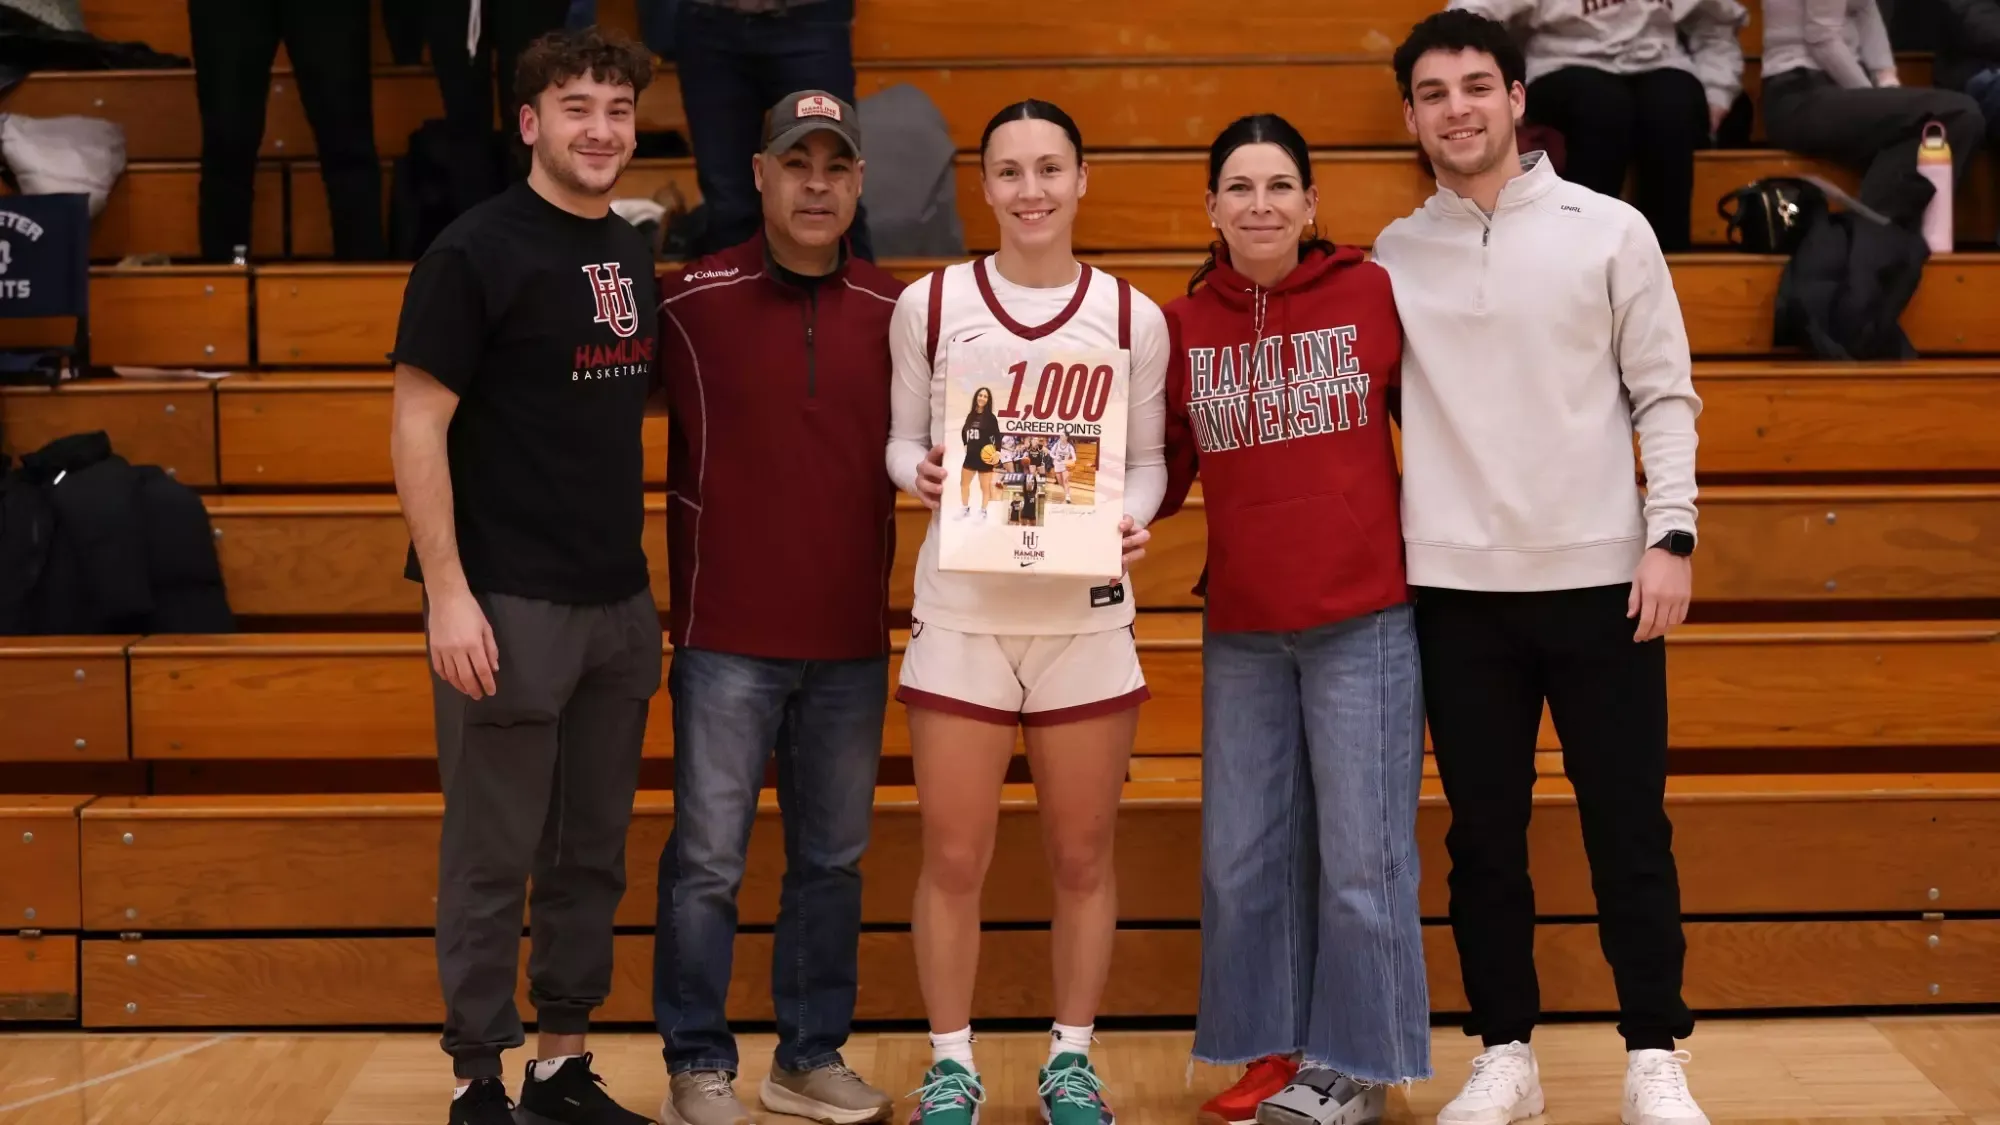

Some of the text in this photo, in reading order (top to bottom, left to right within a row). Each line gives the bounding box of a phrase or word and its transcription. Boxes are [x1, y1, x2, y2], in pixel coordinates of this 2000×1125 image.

[694, 267, 740, 280] Columbia
[1188, 324, 1360, 401] HAMLINE
[997, 360, 1114, 423] 1,000
[1187, 374, 1370, 452] UNIVERSITY
[1006, 420, 1102, 436] CAREER POINTS
[1013, 549, 1045, 558] HAMLINE
[1113, 589, 1121, 599] M
